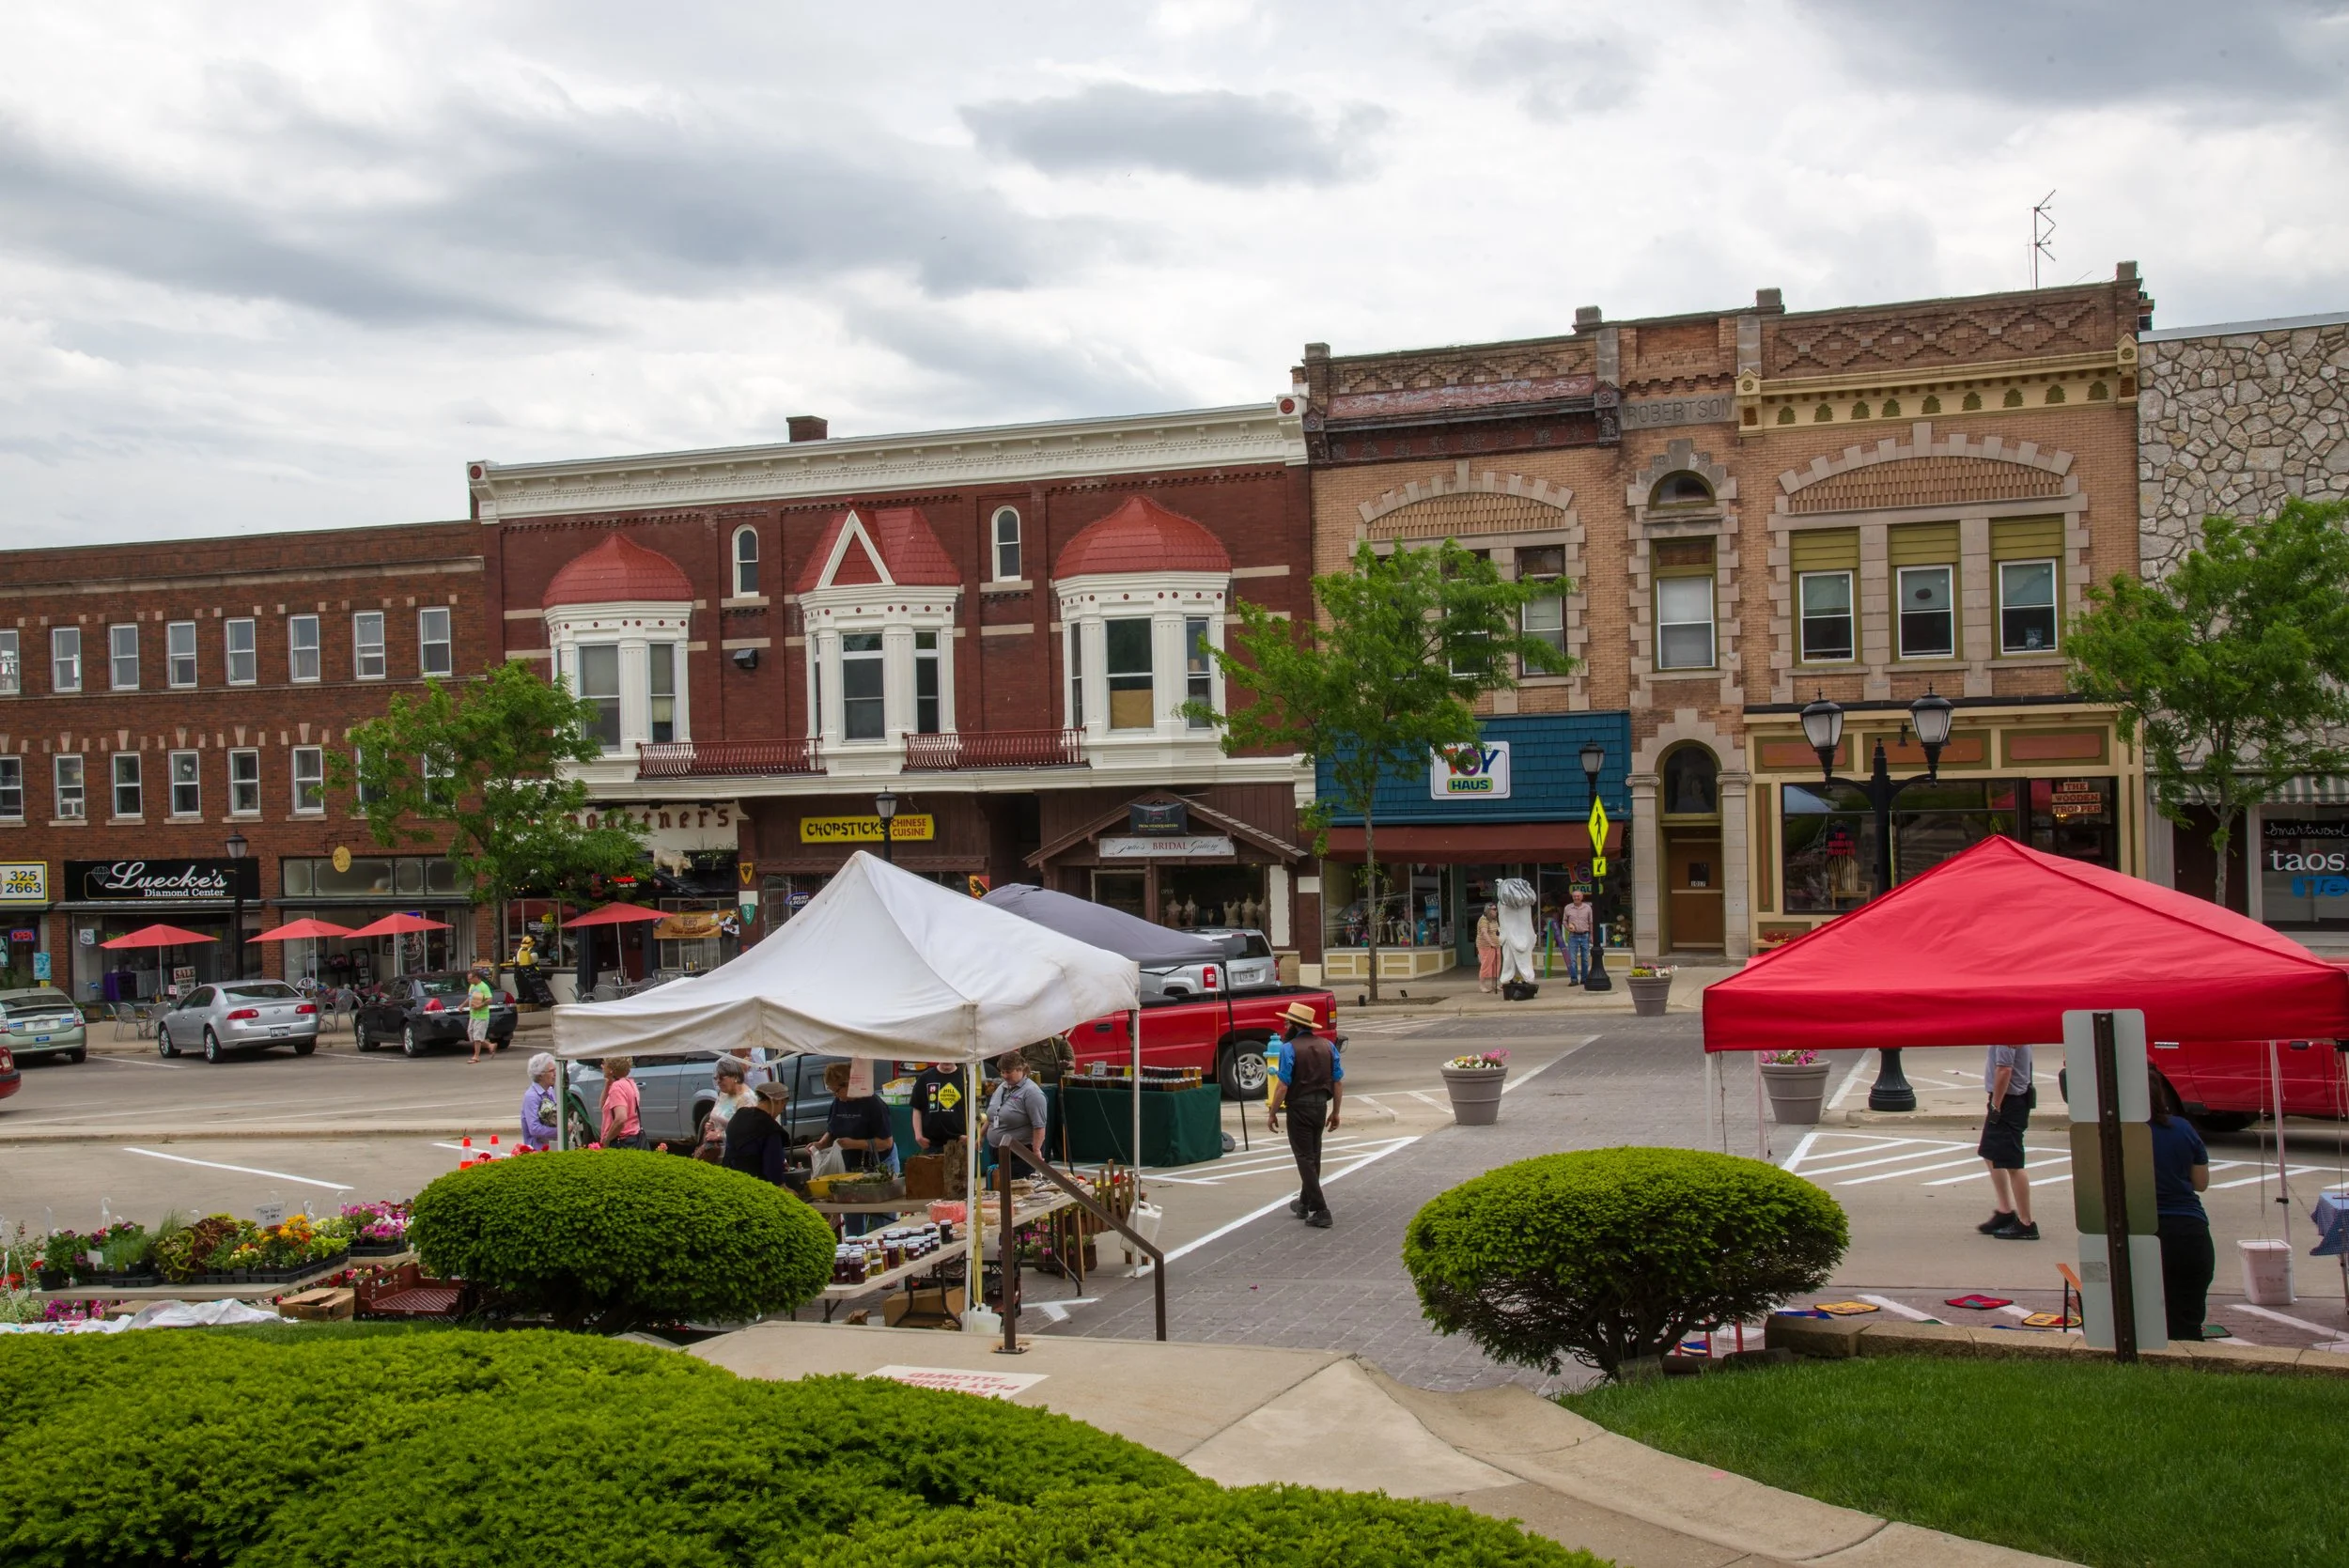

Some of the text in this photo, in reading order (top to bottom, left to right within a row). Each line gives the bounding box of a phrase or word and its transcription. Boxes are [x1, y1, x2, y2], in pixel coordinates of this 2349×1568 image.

[1626, 398, 1733, 427] ROBERTSON
[1443, 747, 1501, 776] TOY
[1452, 780, 1489, 790] HAUS
[2065, 783, 2088, 791] THE
[2055, 794, 2099, 802] WOODEN
[806, 820, 888, 837] CHOPSTICKS
[891, 818, 927, 828] CHINESE
[893, 828, 926, 837] CUISINE
[1152, 842, 1188, 850] BRIDAL
[1188, 839, 1220, 854] Gallery
[9, 870, 38, 882] 325
[105, 862, 227, 889] Luecke's
[1563, 861, 1594, 883] TO
[6, 882, 42, 893] 2663
[144, 887, 226, 897] Diamond Center
[176, 969, 194, 979] SALE
